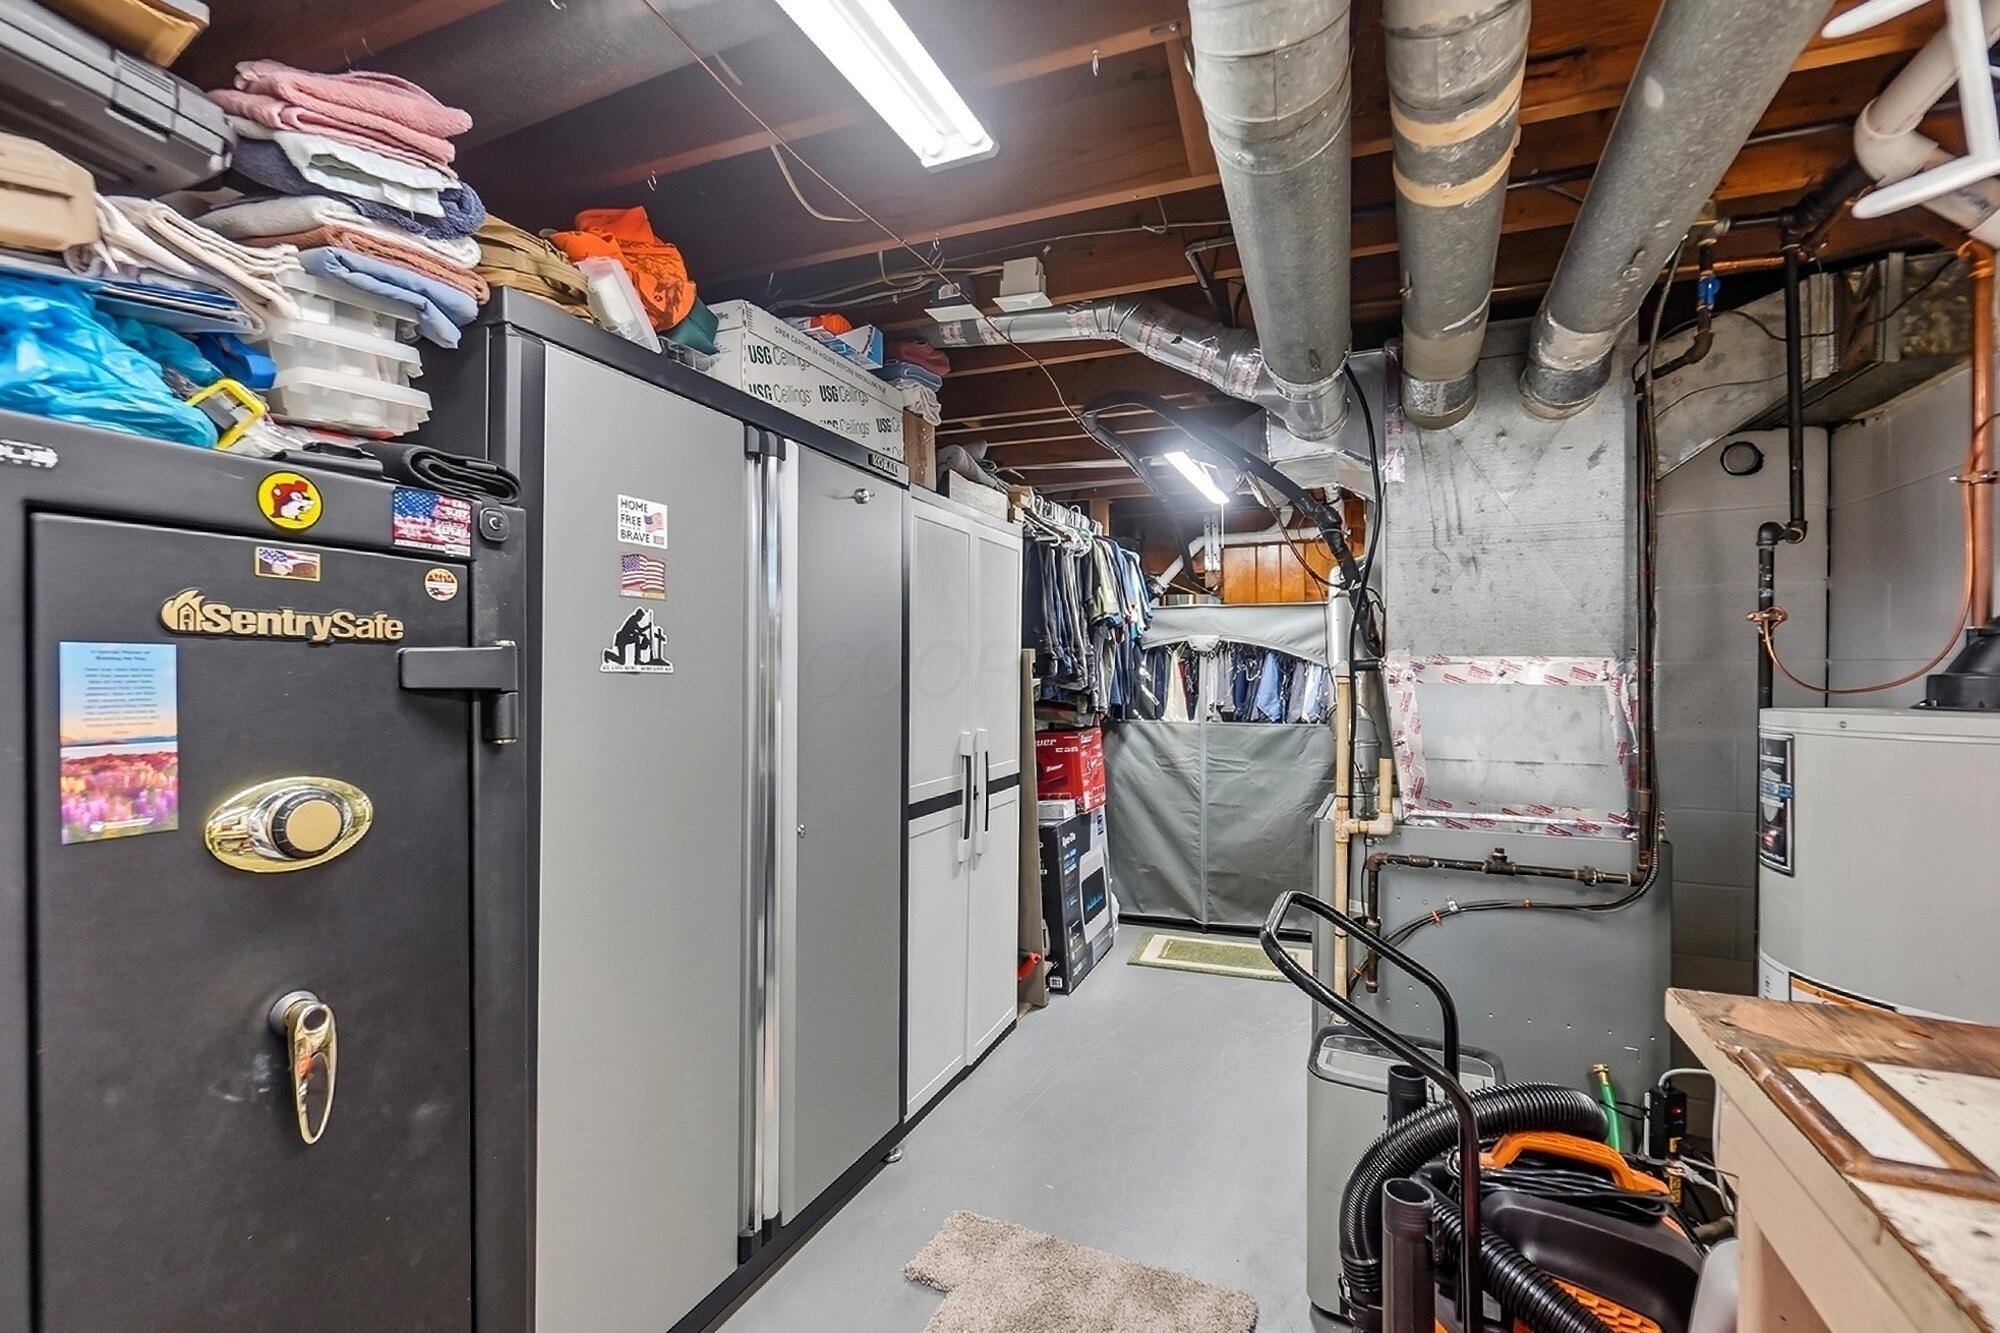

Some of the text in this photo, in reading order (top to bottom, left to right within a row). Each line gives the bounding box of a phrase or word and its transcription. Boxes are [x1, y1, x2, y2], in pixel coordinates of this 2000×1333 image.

[748, 344, 773, 364] USG
[773, 383, 812, 407] Ceilings
[819, 384, 839, 403] USG
[876, 418, 892, 434] USG
[620, 498, 648, 514] HOME
[620, 513, 642, 526] FREE
[620, 529, 651, 544] BRAVE
